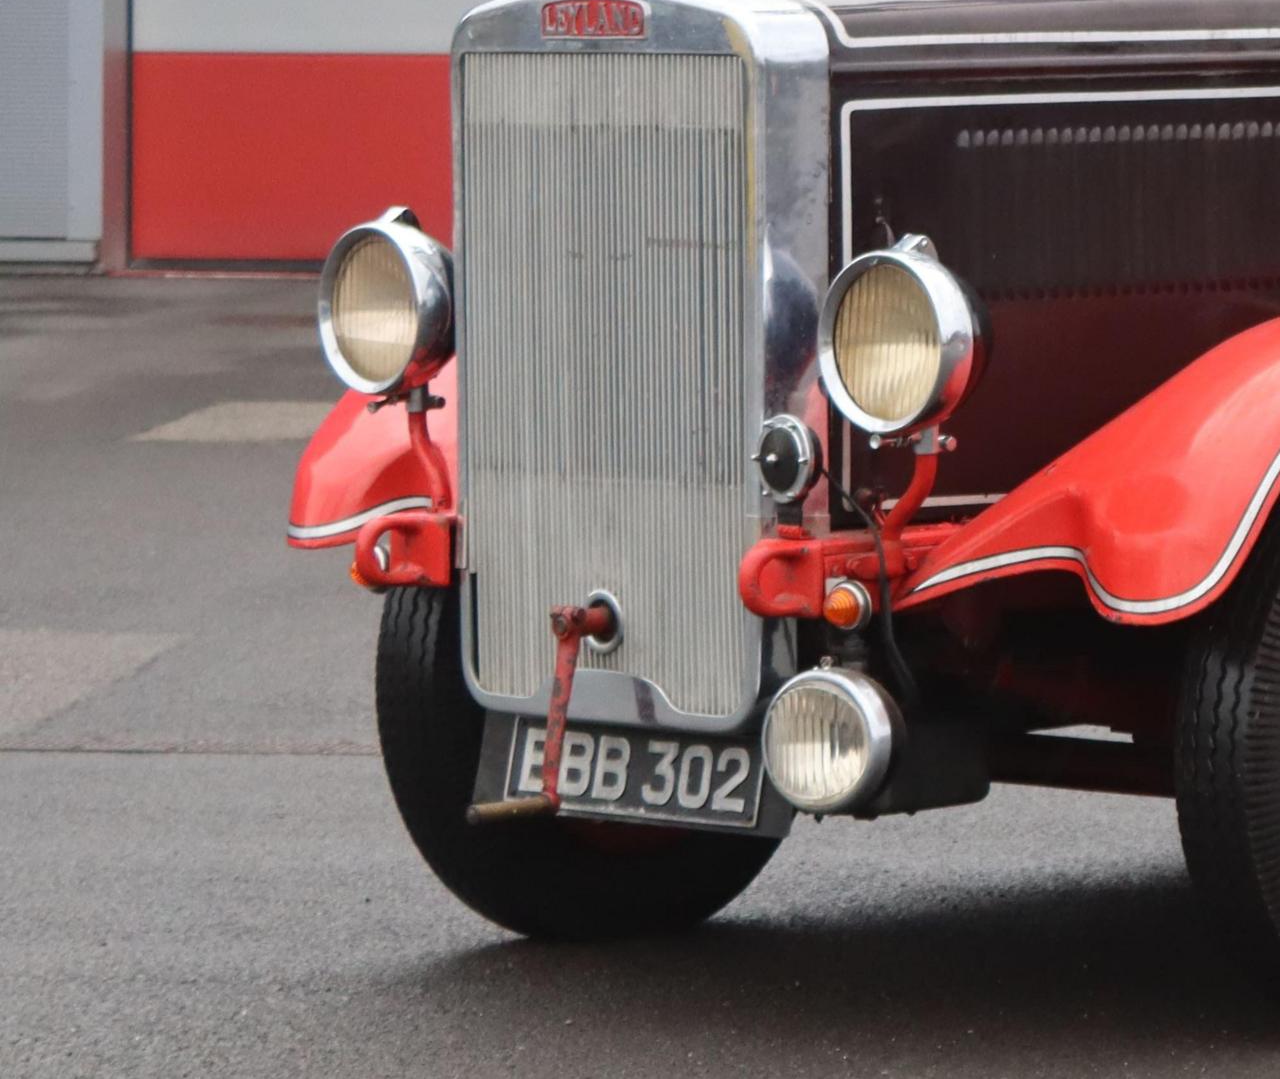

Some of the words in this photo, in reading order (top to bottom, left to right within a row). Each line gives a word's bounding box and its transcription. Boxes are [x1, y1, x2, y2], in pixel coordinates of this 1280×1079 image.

[545, 1, 641, 35] LEYLAND
[517, 728, 631, 801] EBB
[640, 739, 750, 813] 302
